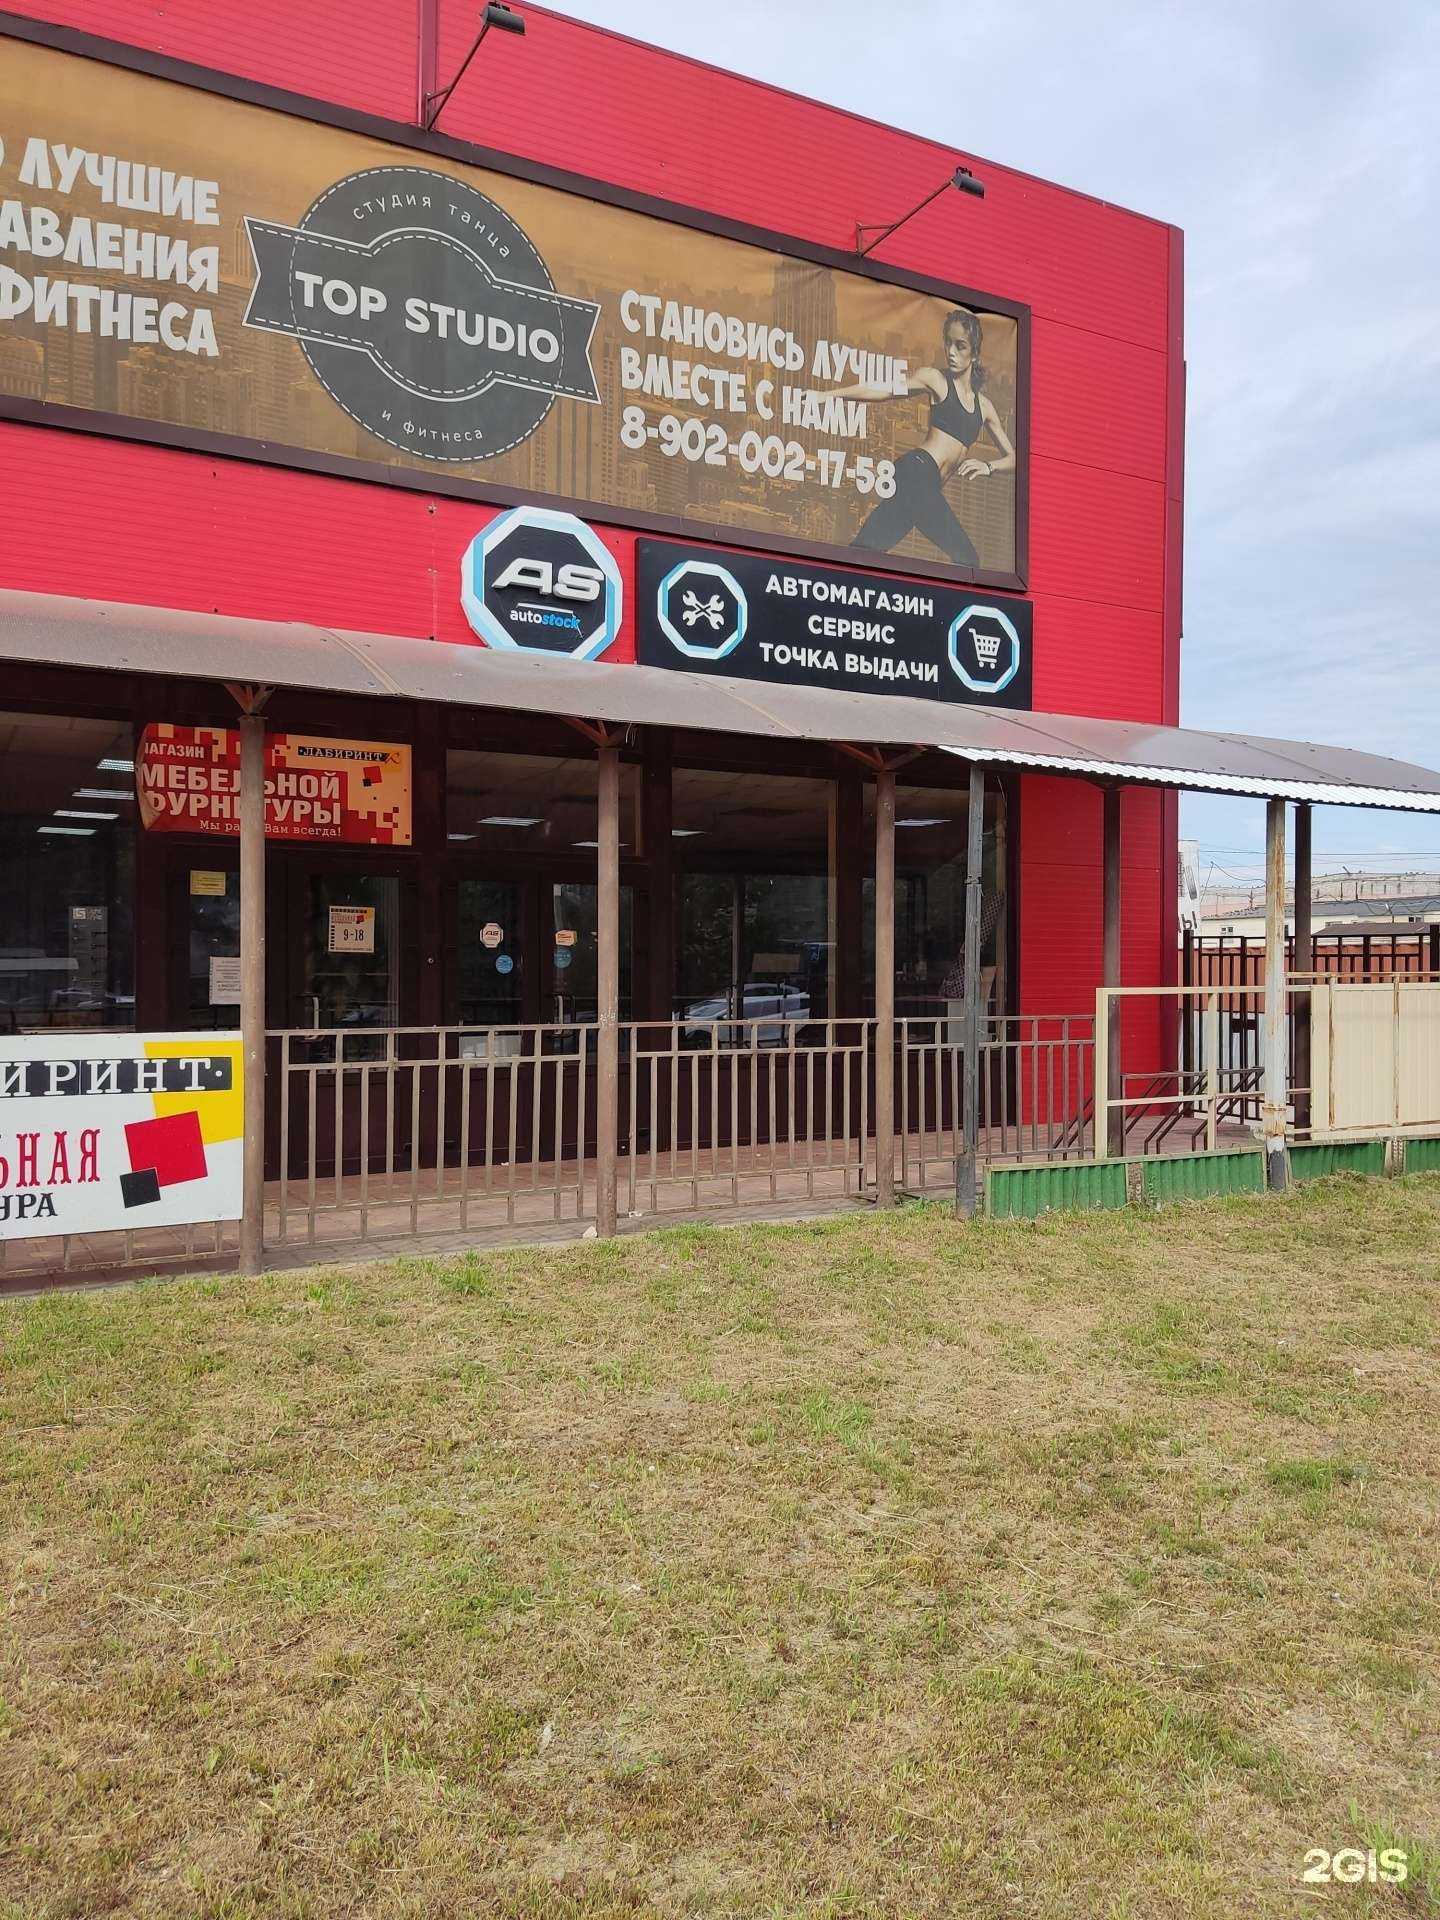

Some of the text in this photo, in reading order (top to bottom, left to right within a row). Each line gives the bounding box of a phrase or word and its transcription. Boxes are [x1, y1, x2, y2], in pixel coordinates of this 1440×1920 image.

[19, 138, 220, 225] ЛУЧШИЕ
[0, 200, 219, 294] АВЛЕНИЯ
[353, 194, 510, 258] студия танца
[295, 271, 560, 363] TOP STUDIO
[620, 289, 908, 396] СТАНОВИСЬ ЛУЧШЕ
[620, 347, 867, 439] ВМЕСТЕ С НАМИ
[382, 409, 483, 442] и фитнеса
[620, 406, 897, 499] 8-902-002-17-58
[491, 557, 605, 602] AS
[765, 574, 934, 617] АВТОМАГАЗИН
[510, 608, 581, 630] autostock
[808, 615, 896, 644] СЕРВИС
[759, 642, 939, 683] ТОЧКА ВЫДАЧИ
[303, 747, 383, 762] ЛАБИРИНТ
[200, 820, 220, 830] Мы
[294, 828, 342, 838] всегда!
[343, 928, 365, 942] 9-18
